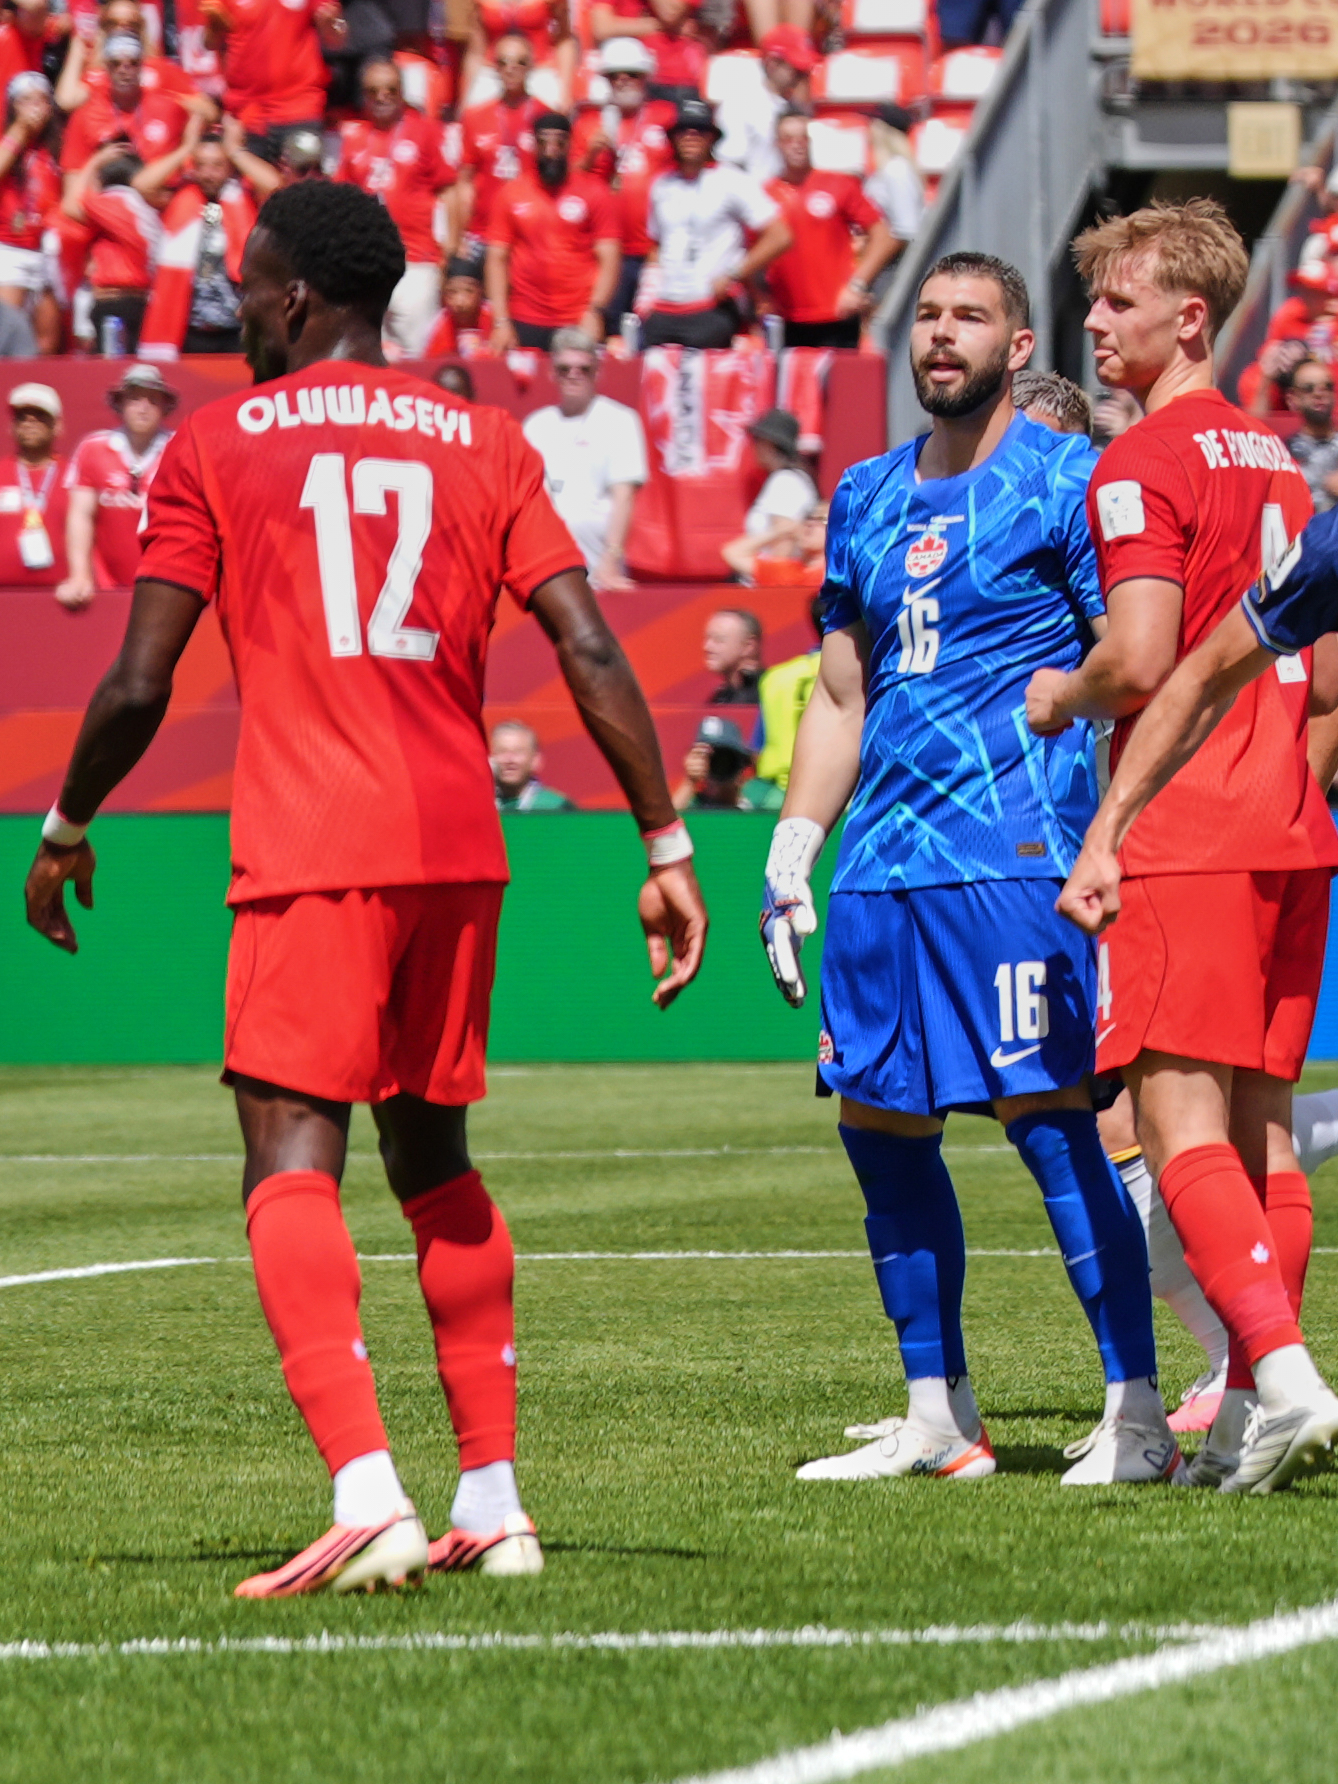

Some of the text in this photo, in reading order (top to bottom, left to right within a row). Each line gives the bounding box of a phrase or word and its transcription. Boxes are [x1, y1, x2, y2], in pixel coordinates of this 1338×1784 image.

[1192, 18, 1330, 46] 2026
[237, 384, 472, 446] OLUWASEYI
[1193, 429, 1230, 470] DE
[299, 453, 440, 661] 12
[897, 598, 940, 673] 16
[994, 961, 1049, 1041] 16
